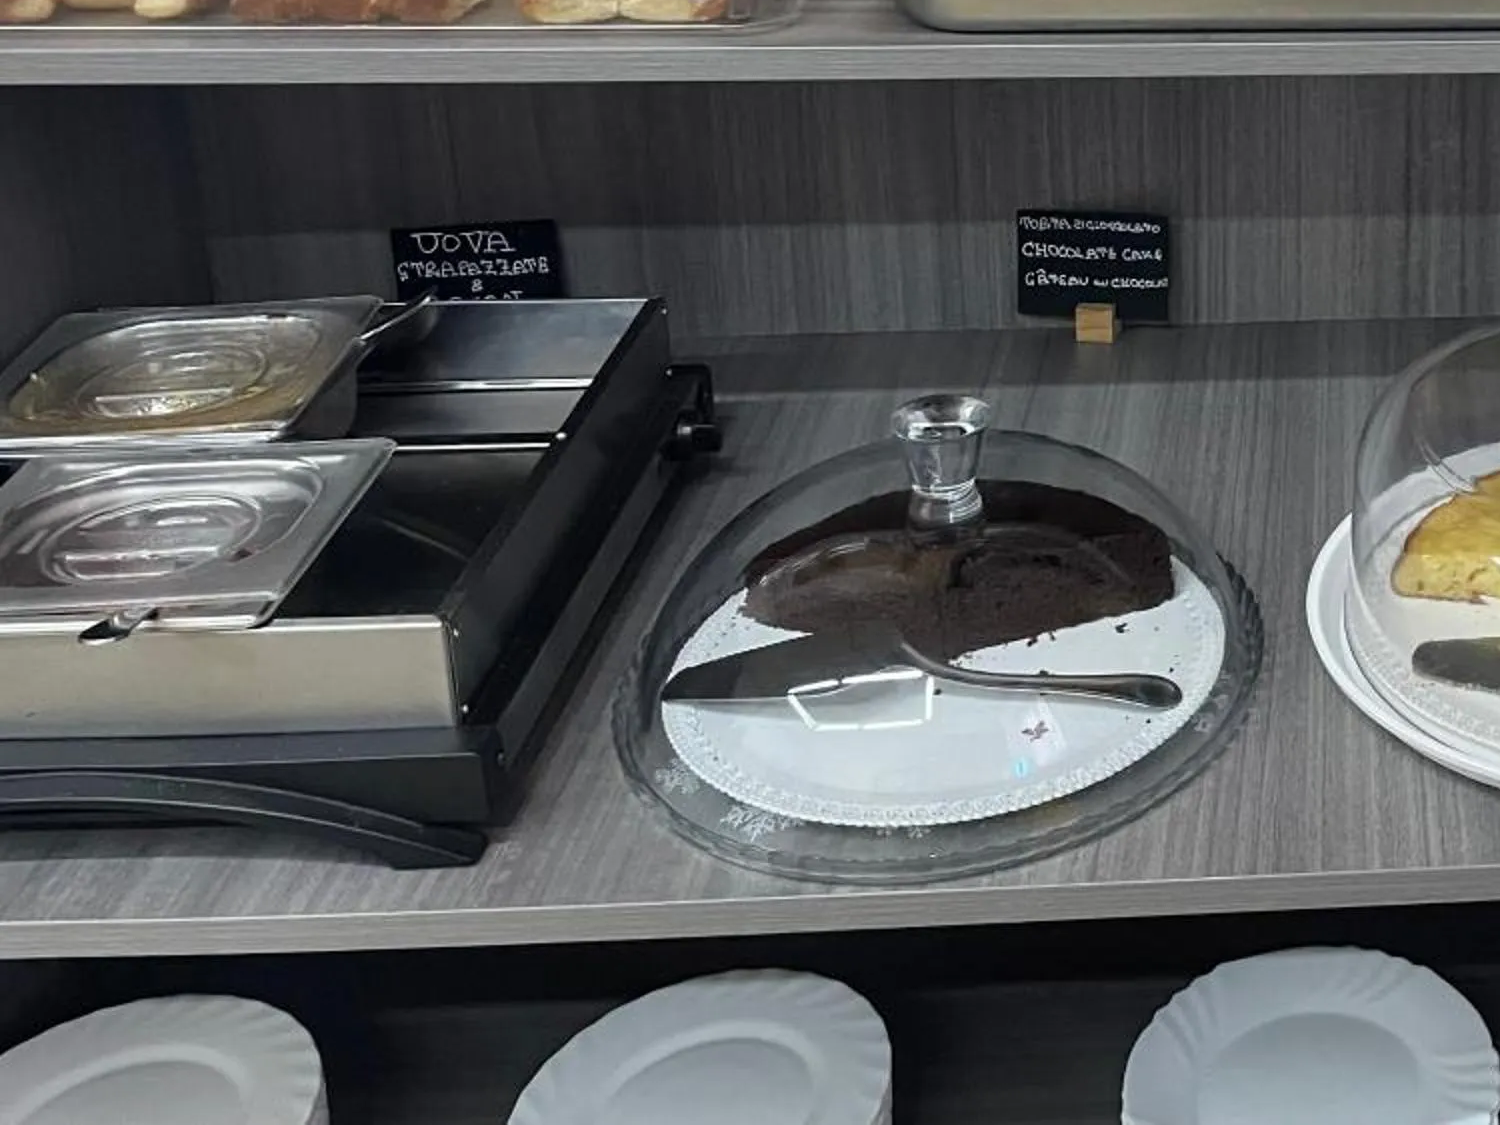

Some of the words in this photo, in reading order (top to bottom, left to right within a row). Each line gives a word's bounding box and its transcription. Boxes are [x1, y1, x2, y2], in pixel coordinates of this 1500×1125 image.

[1019, 216, 1071, 232] TORTA
[409, 230, 517, 254] UOVA
[1021, 241, 1117, 260] CHOCOLATE
